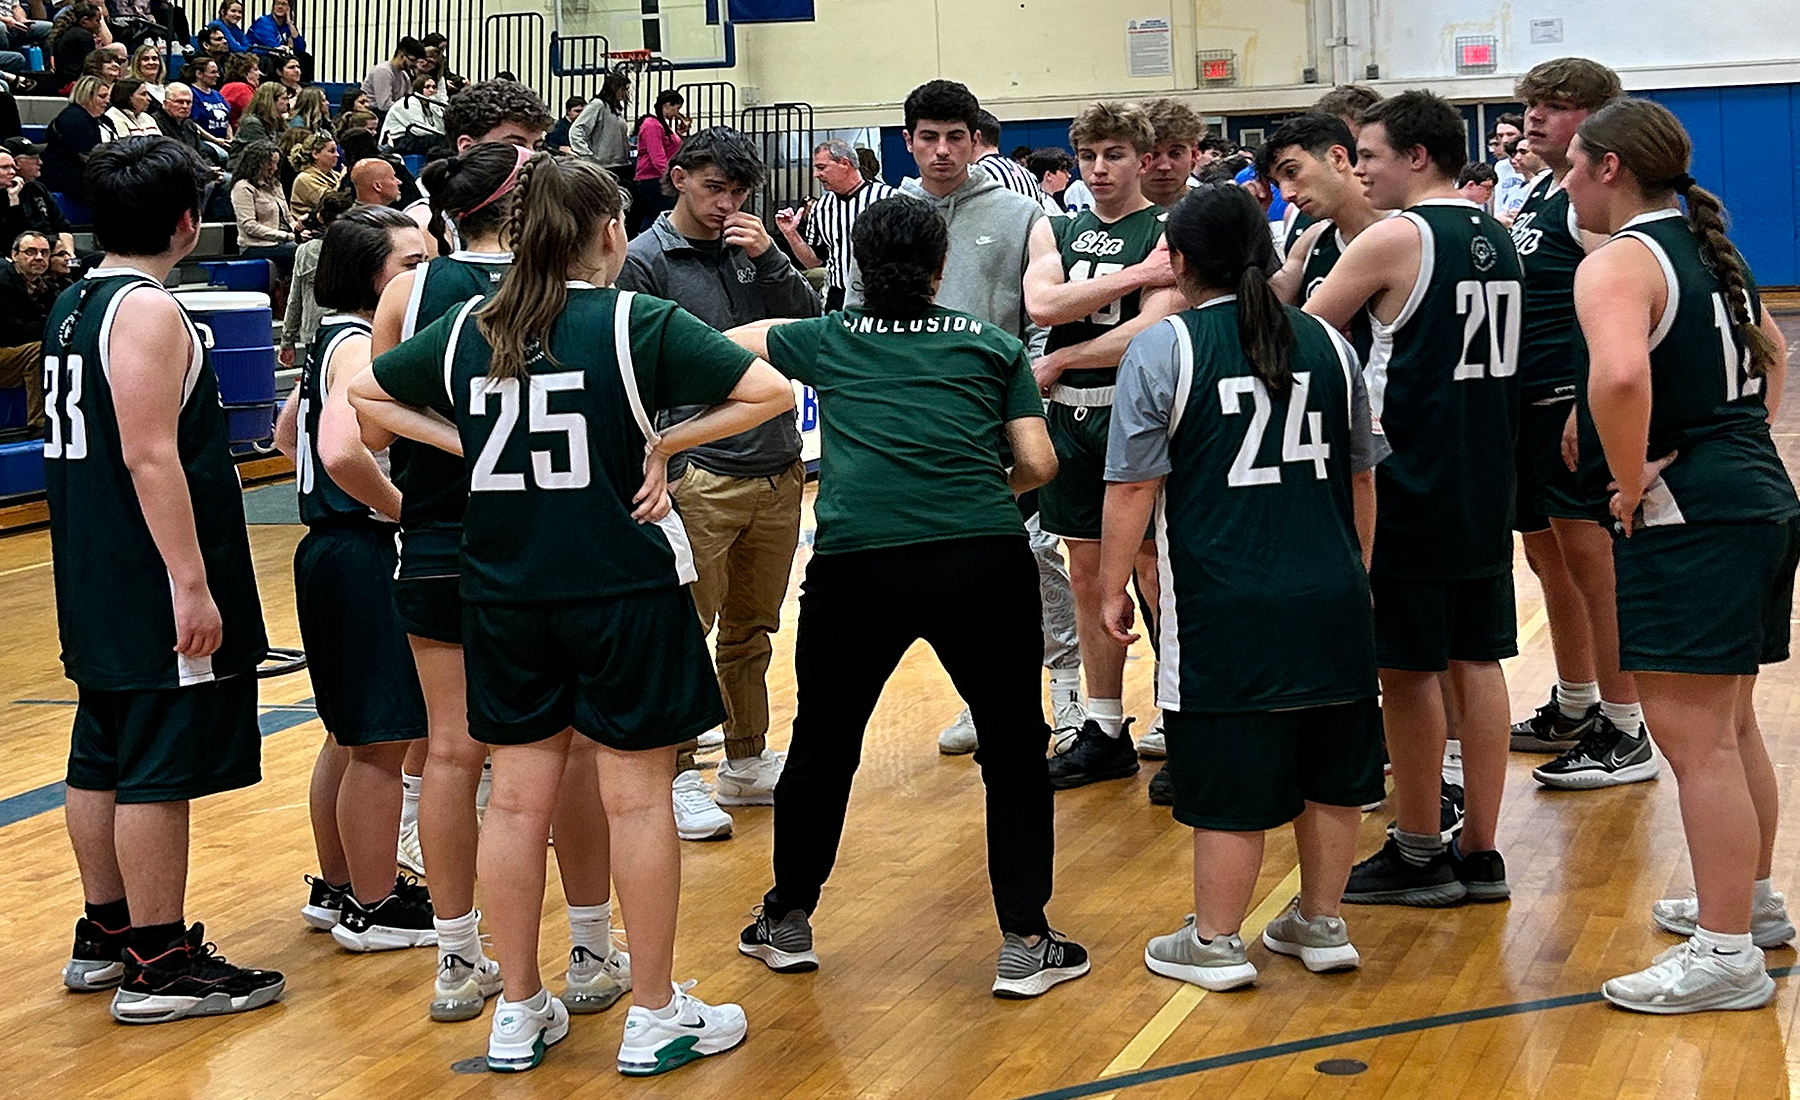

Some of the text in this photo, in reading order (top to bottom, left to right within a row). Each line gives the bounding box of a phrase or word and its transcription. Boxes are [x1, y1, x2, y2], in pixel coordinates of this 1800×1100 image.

[1203, 61, 1227, 78] EXIT
[1453, 280, 1522, 381] 20
[43, 354, 88, 460] 33
[469, 370, 591, 492] 25
[1217, 371, 1331, 488] 24
